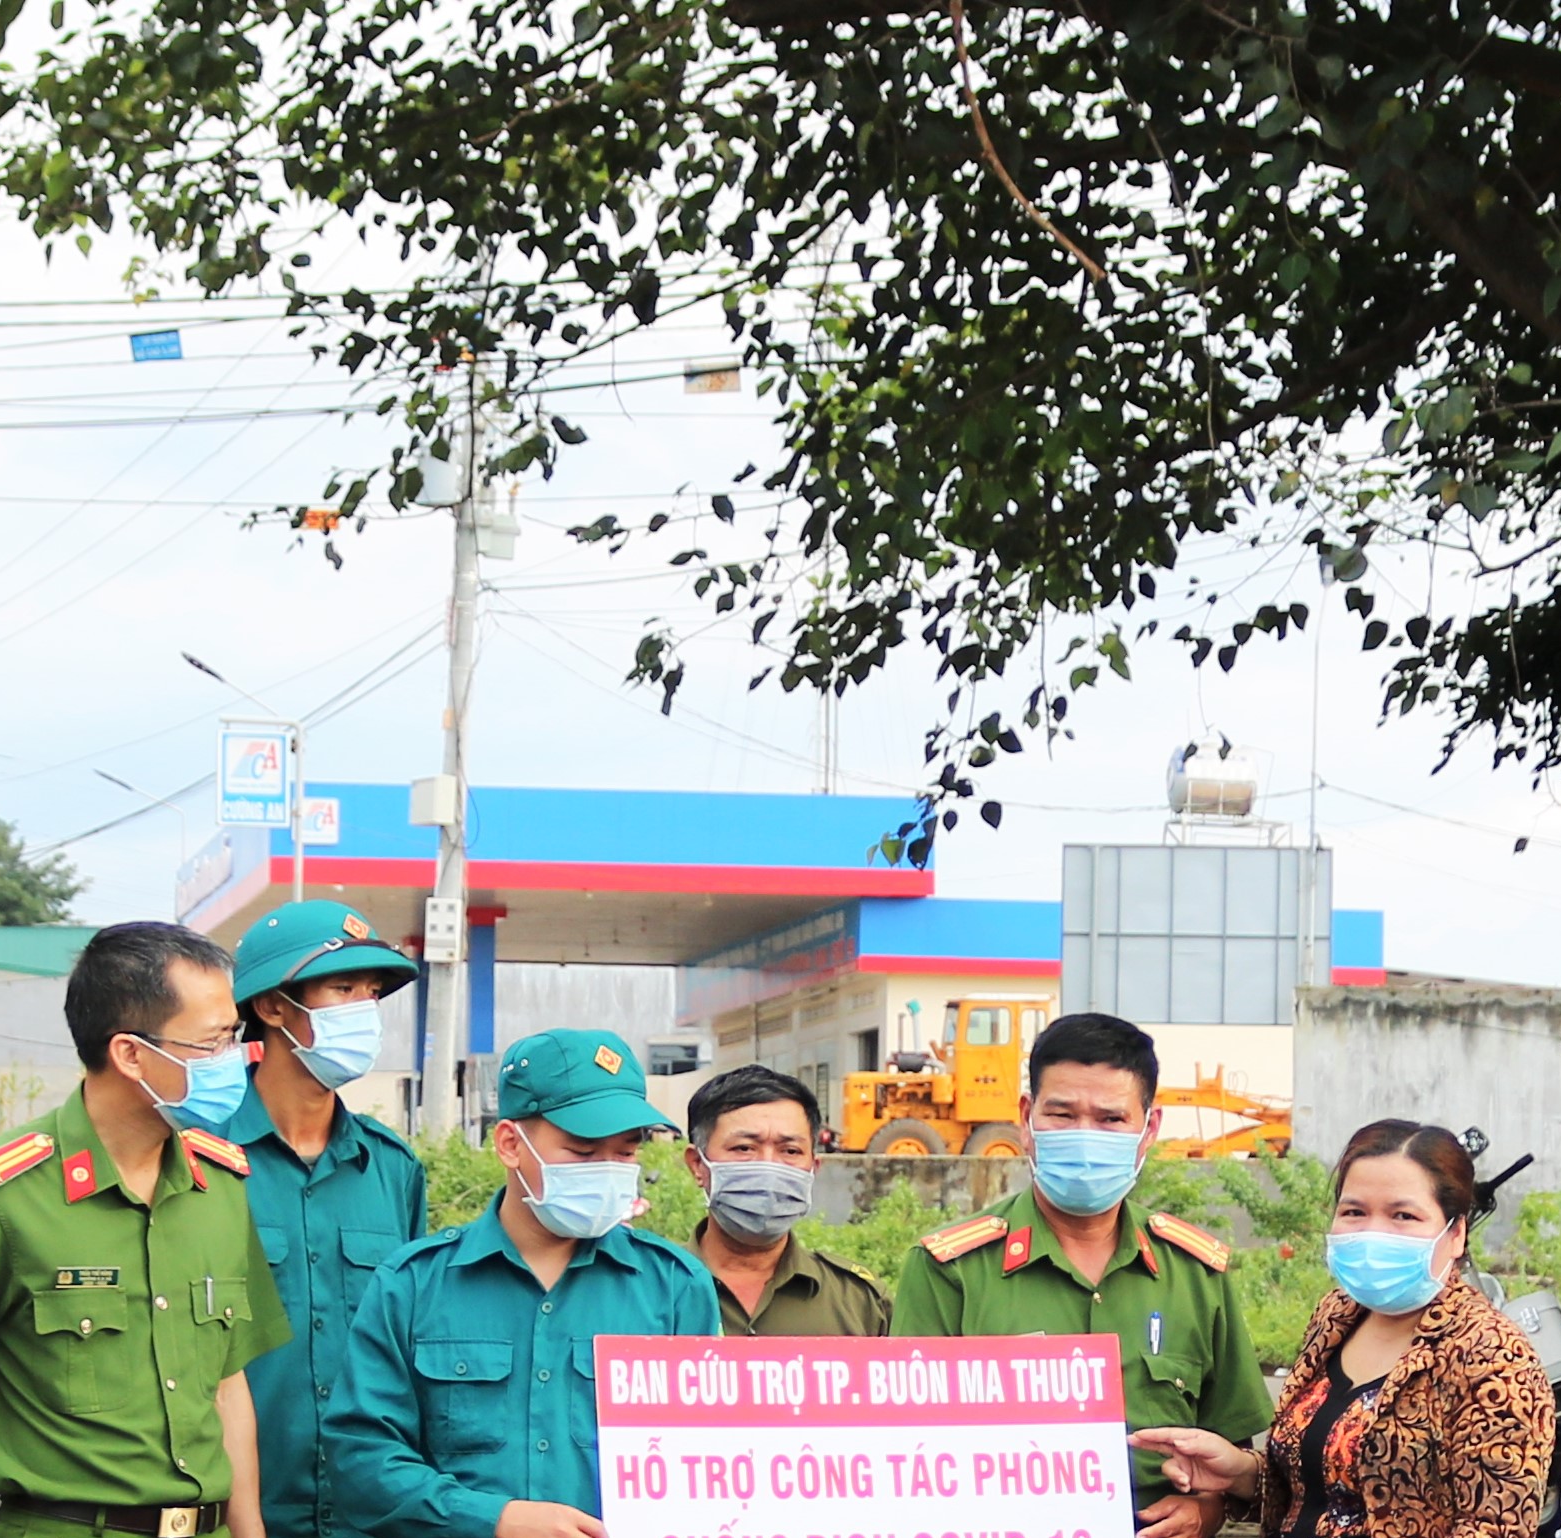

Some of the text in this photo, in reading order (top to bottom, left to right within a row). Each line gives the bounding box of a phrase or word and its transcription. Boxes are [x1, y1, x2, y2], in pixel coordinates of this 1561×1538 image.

[609, 1348, 1107, 1415] BAN CỨU TRỢ TP. BUÔN MA THUỘT
[616, 1437, 1116, 1510] HỖ TRỢ CÔNG TÁC PHÒNG,
